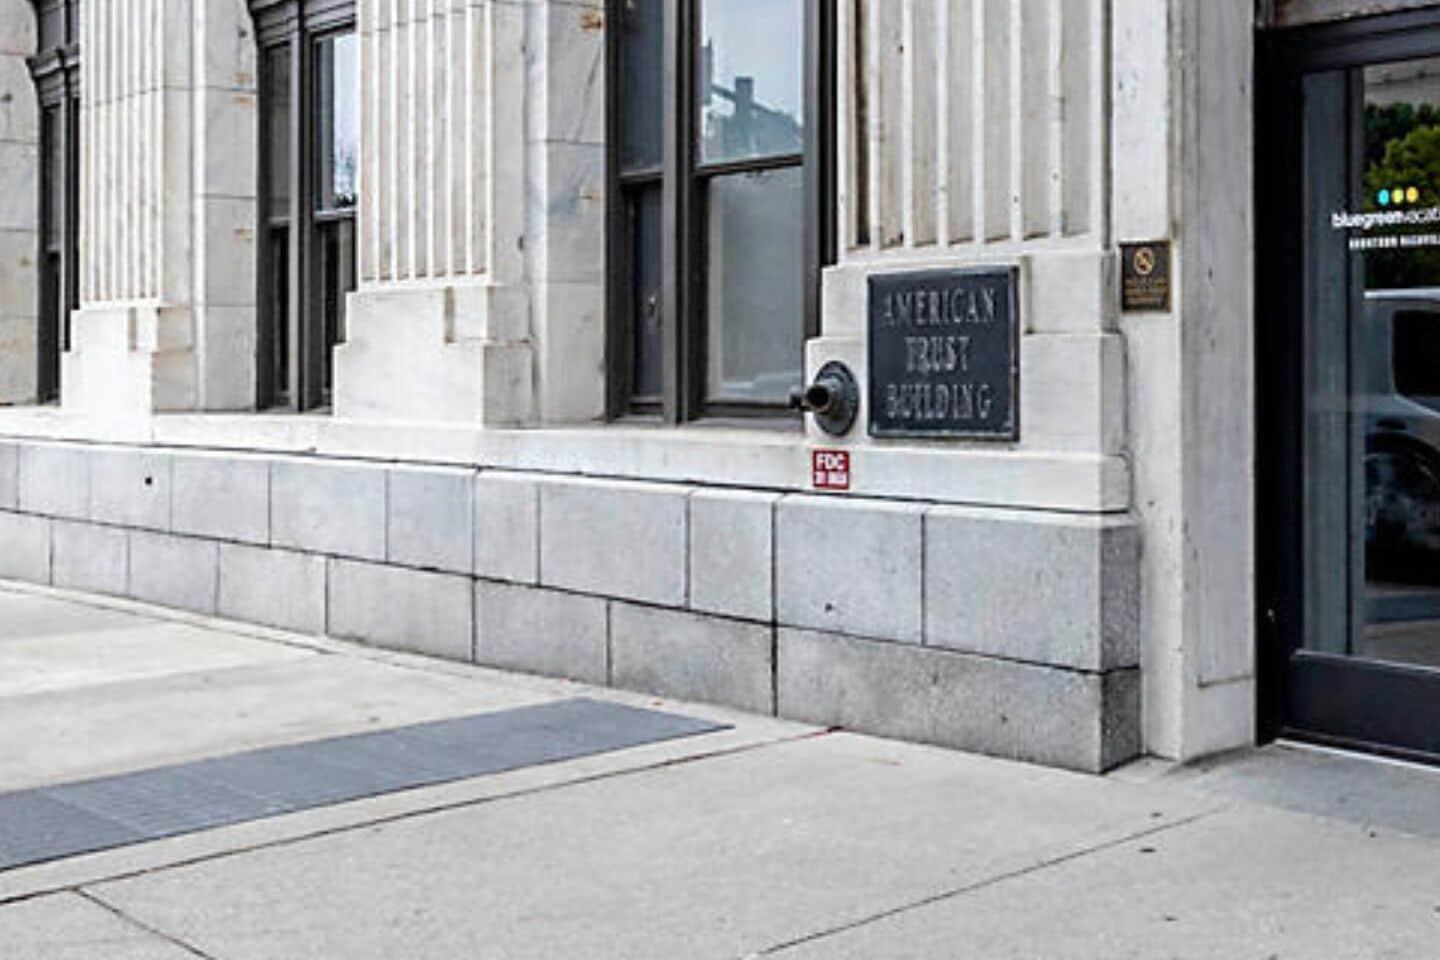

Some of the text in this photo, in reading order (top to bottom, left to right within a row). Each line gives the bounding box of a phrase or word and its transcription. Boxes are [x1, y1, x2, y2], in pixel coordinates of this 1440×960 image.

[883, 286, 997, 328] AMERICAN
[904, 336, 970, 373] TRUST
[887, 383, 993, 420] BUILDING
[815, 453, 845, 470] FDC
